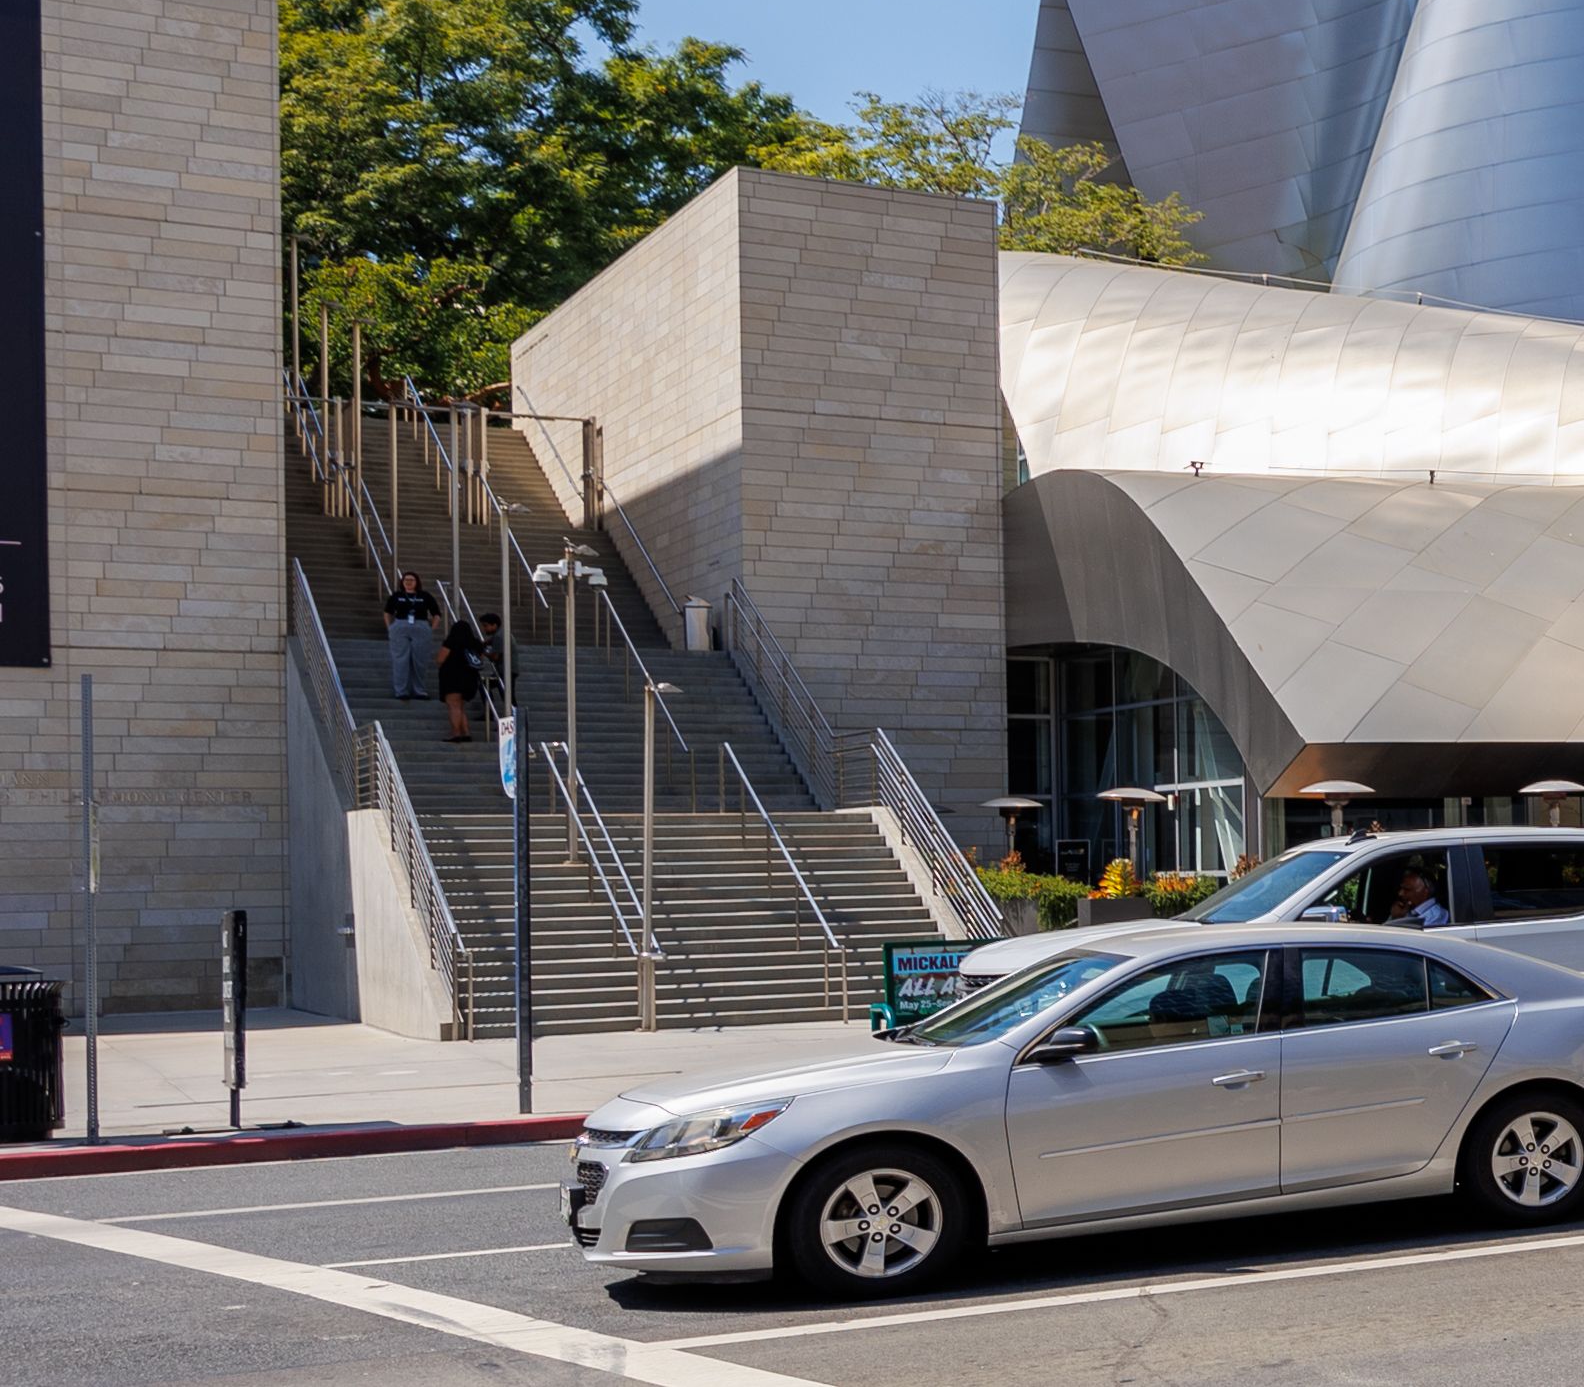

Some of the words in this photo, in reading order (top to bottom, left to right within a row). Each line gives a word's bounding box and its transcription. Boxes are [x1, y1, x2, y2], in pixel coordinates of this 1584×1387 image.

[26, 790, 171, 804] PHILHRMONIC
[899, 977, 935, 997] ALL
[900, 1000, 919, 1010] May
